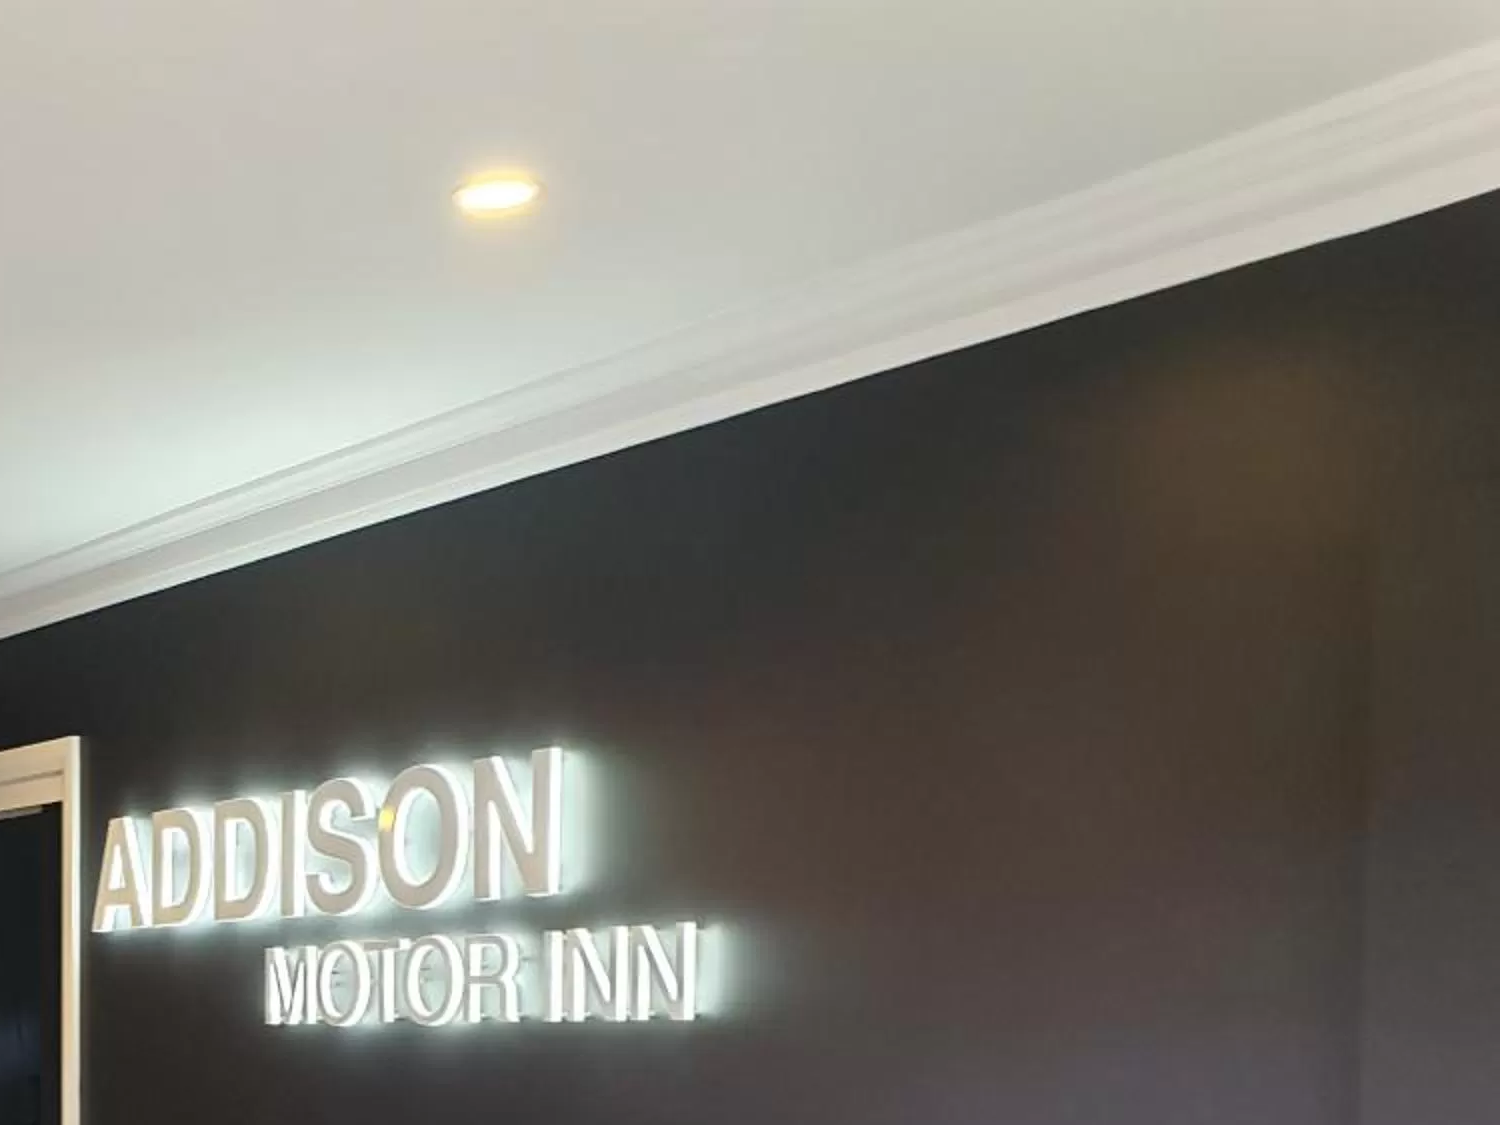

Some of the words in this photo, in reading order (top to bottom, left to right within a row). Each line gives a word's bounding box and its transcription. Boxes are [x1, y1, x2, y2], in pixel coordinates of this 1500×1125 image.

[92, 746, 564, 932] ADDISON
[264, 934, 521, 1026] MOTOR
[543, 921, 698, 1024] INN
